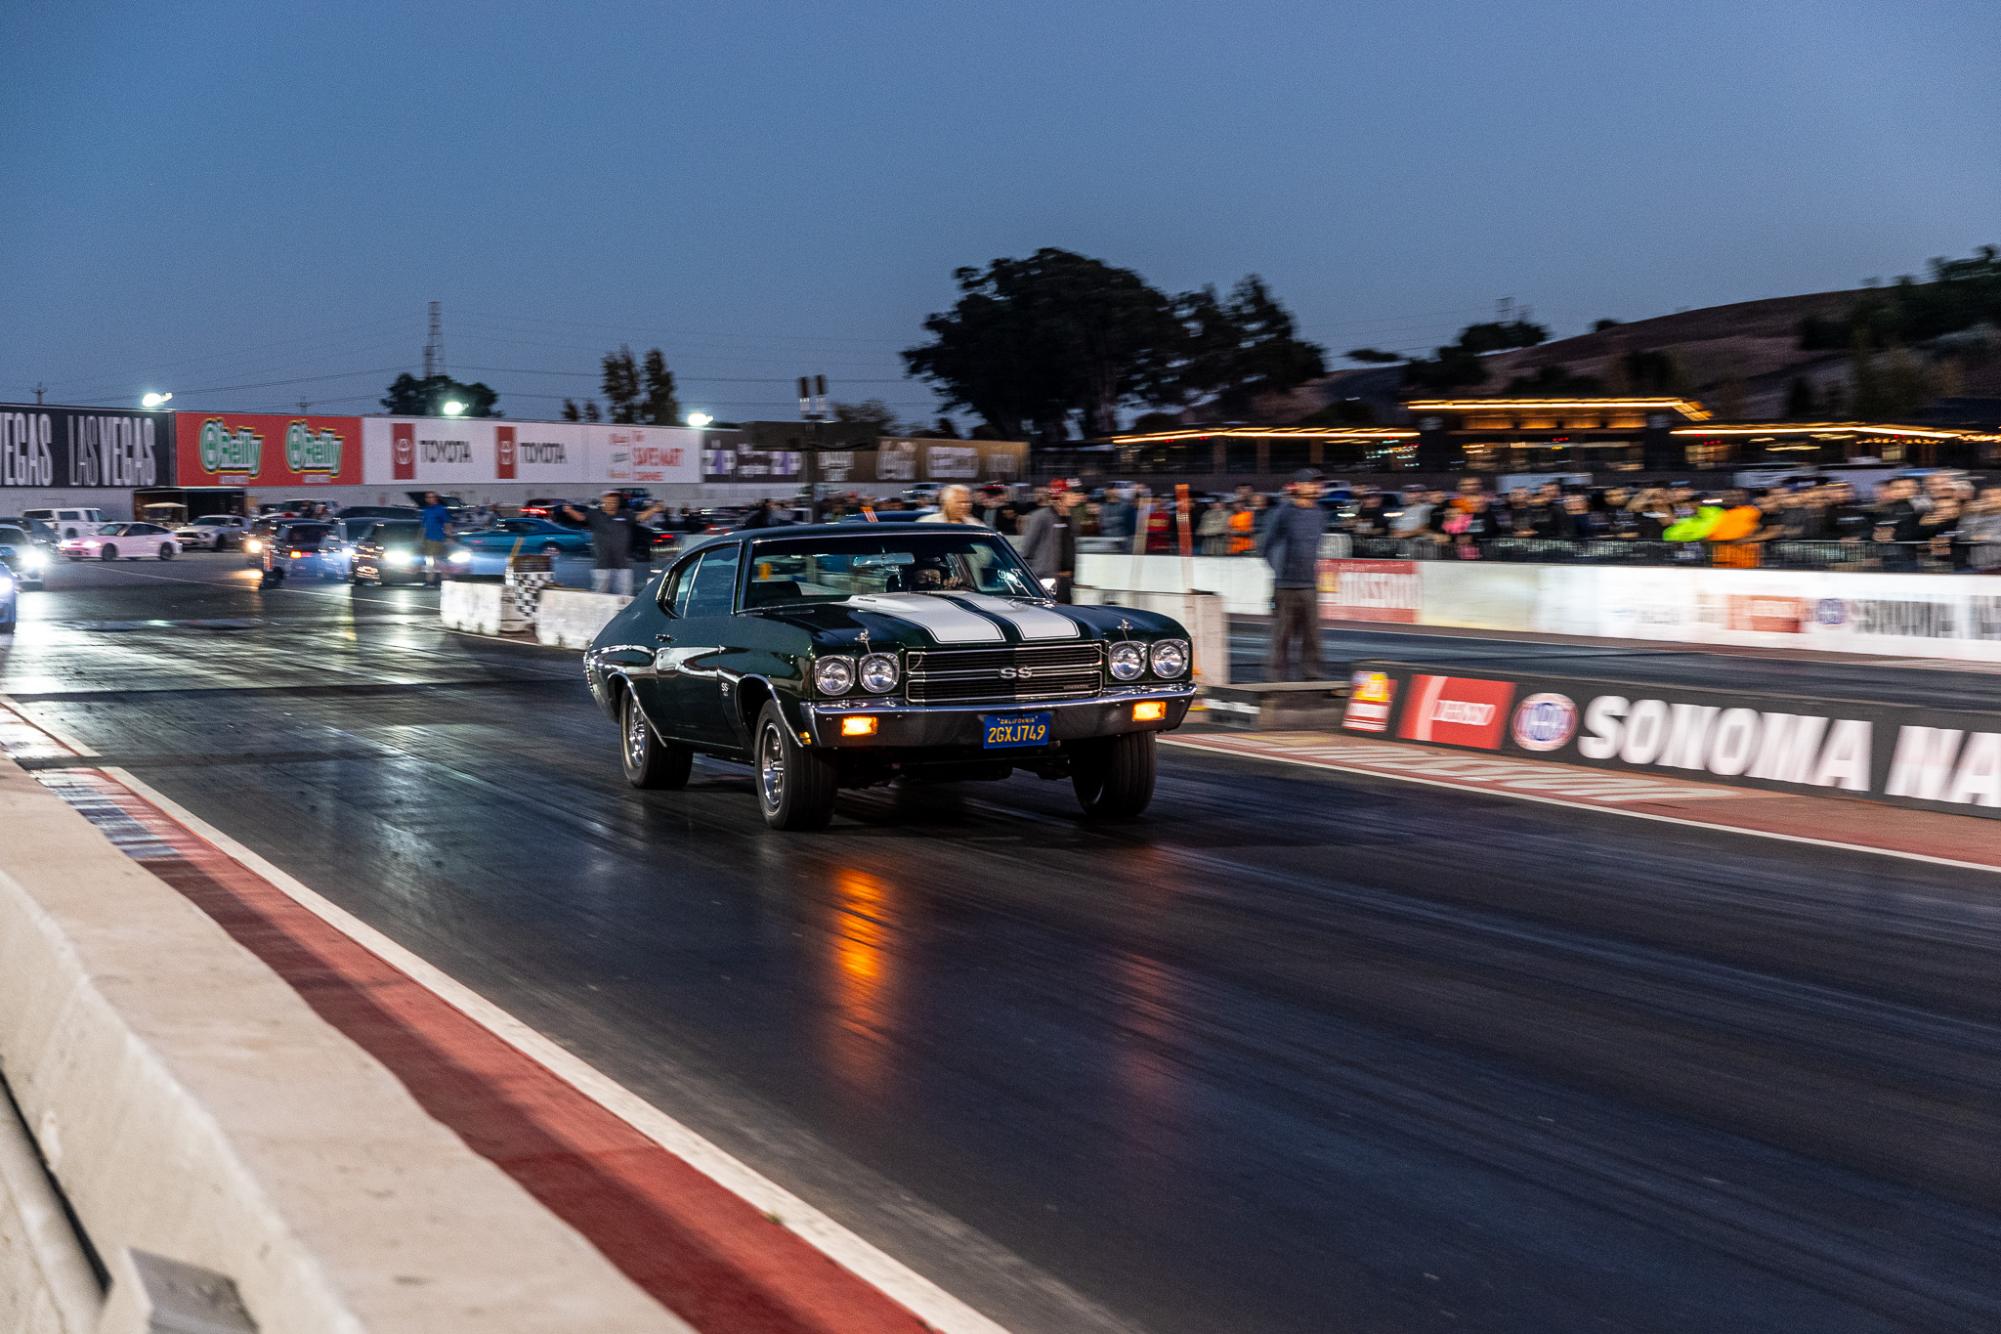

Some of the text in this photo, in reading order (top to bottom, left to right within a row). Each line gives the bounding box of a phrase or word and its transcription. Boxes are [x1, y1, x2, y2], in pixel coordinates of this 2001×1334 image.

[67, 415, 157, 486] LAS VEGAS
[420, 440, 473, 463] TOYOTA
[520, 442, 567, 464] TOYOTA
[1000, 665, 1033, 679] SS
[987, 724, 1047, 744] 2GXJ749
[1577, 695, 1874, 792] SONOMA
